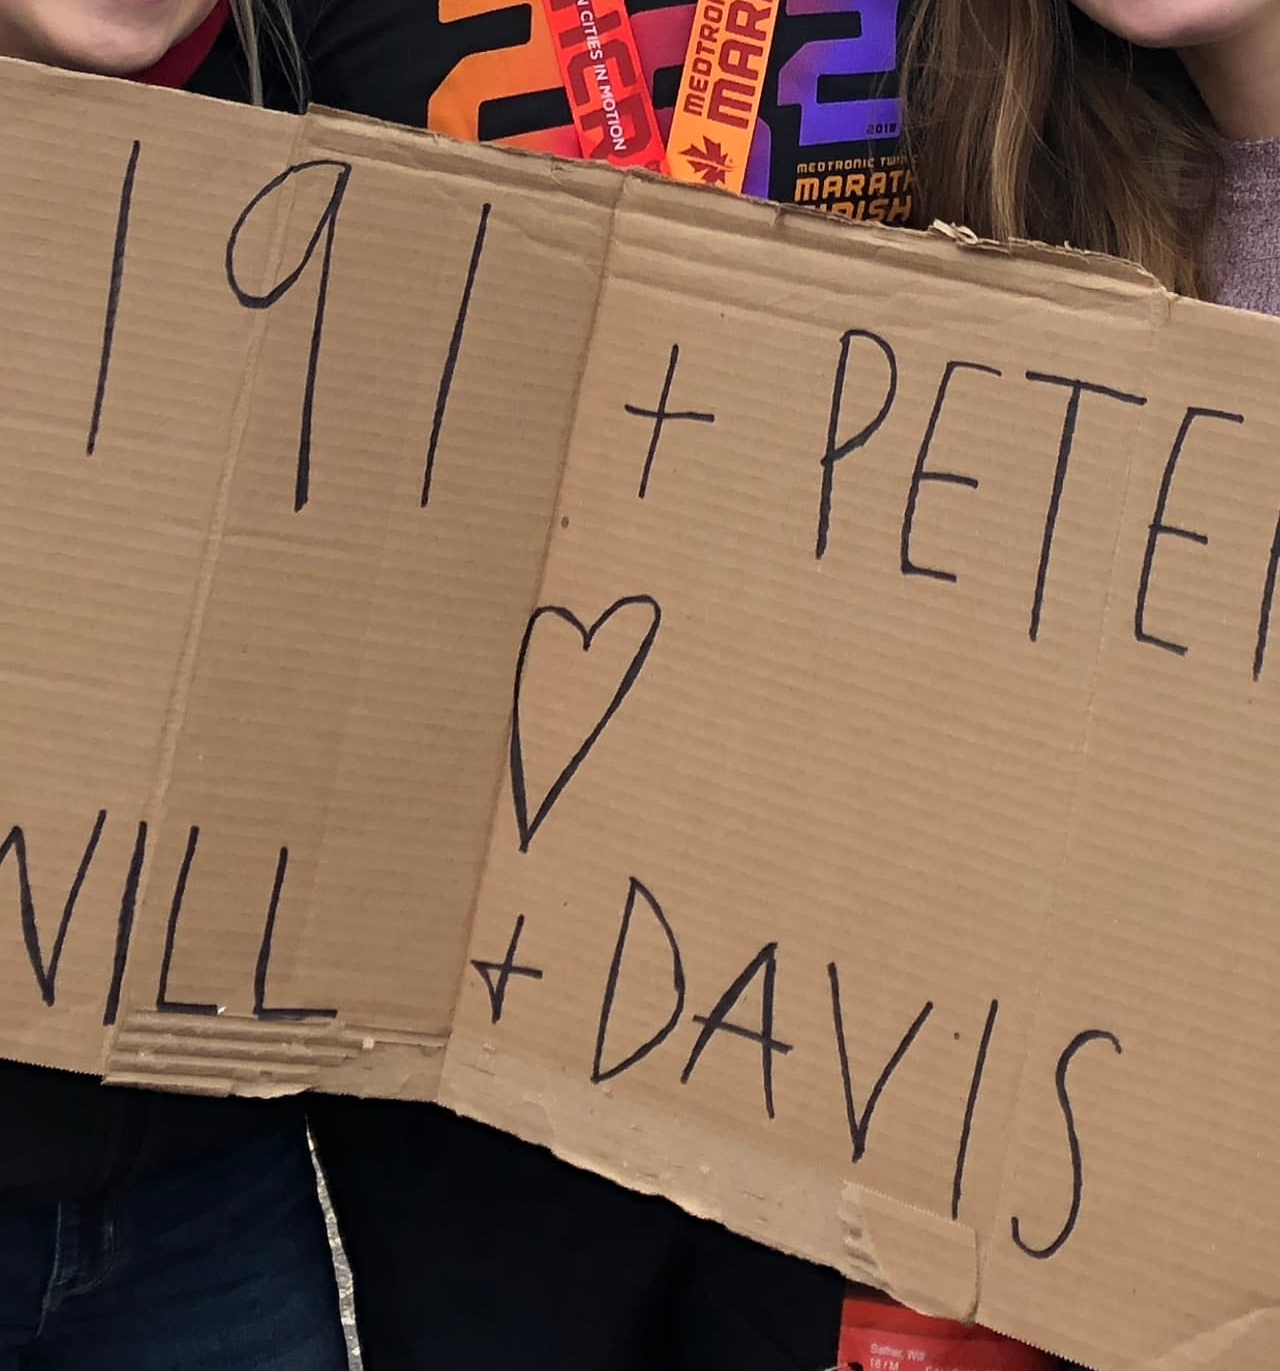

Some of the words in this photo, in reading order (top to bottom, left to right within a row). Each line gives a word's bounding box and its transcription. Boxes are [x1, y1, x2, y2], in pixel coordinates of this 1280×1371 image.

[577, 8, 604, 62] CITIES
[592, 62, 610, 82] IN
[597, 82, 629, 153] MOTION
[794, 169, 919, 202] MARATH
[797, 157, 875, 174] MEDTRONIC
[85, 138, 493, 514] 191
[589, 875, 1123, 1260] DAVIS
